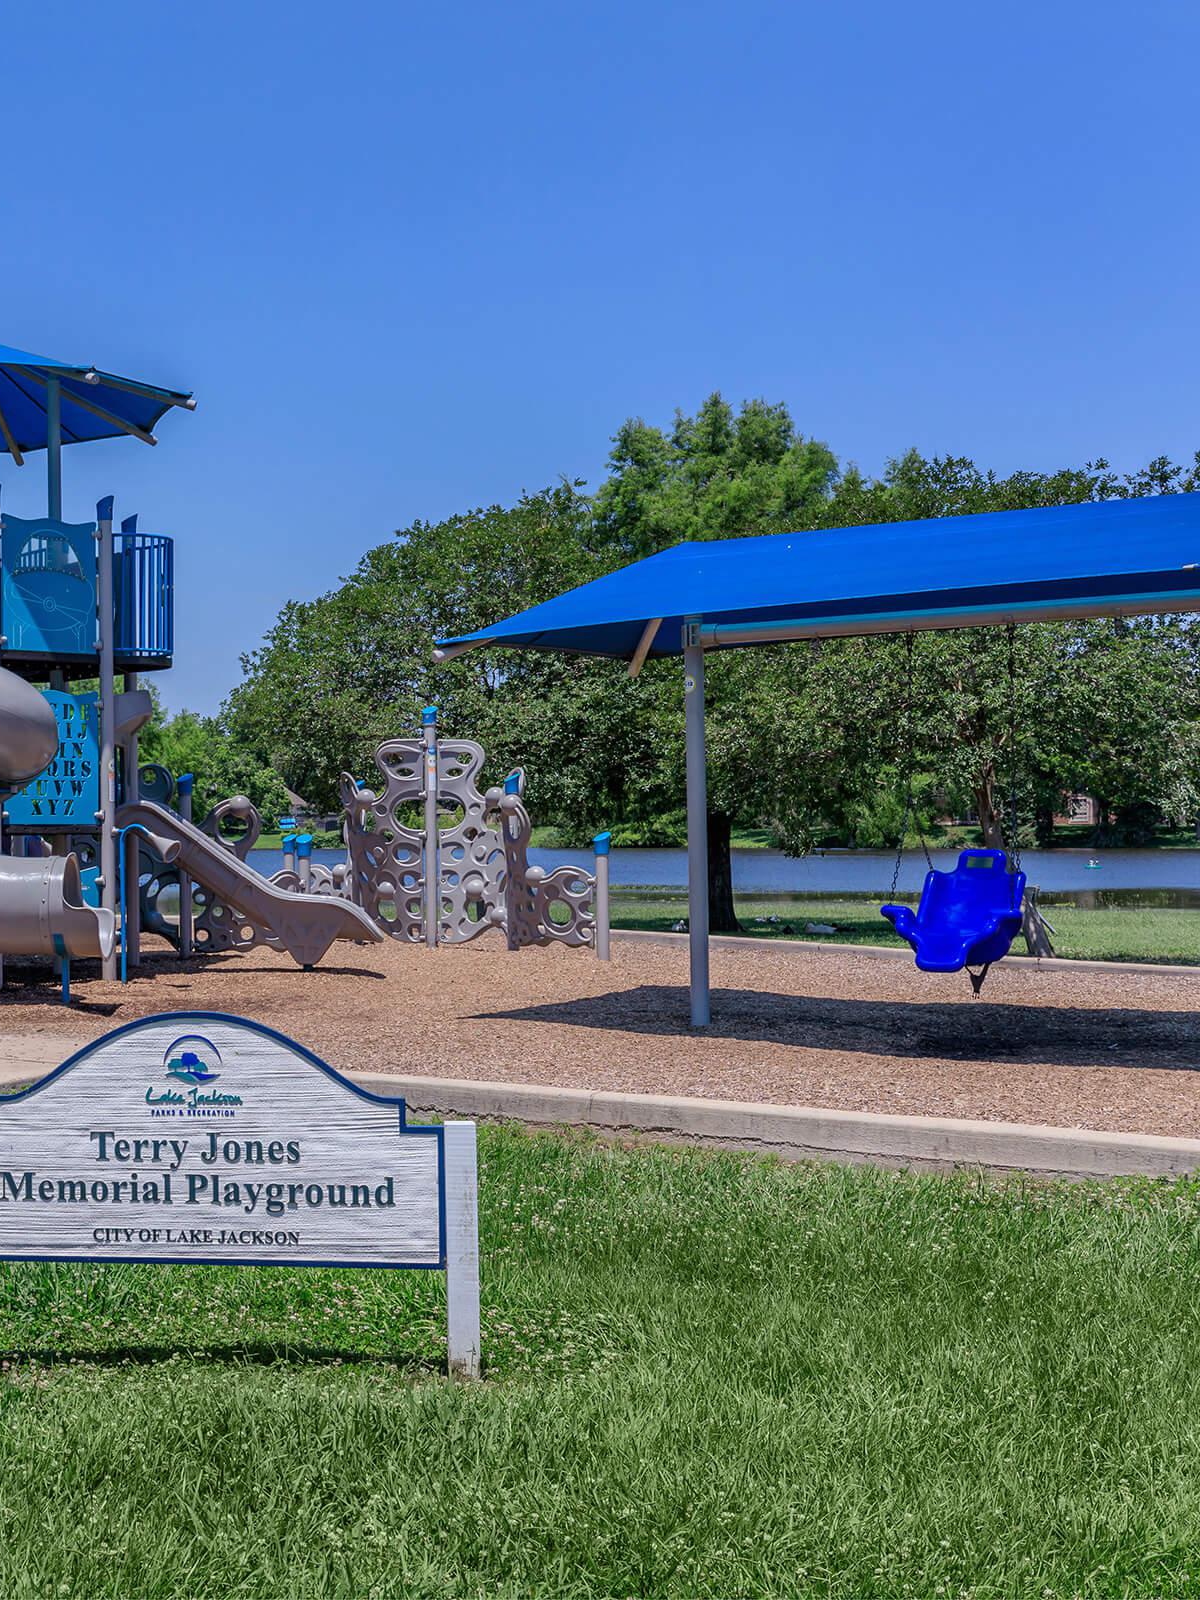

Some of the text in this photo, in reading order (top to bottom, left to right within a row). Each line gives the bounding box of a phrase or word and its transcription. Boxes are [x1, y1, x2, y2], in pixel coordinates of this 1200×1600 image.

[145, 1086, 243, 1108] Lake Jackson
[151, 1109, 235, 1117] PARKS & RECREATION
[90, 1131, 300, 1169] Terry Jones
[0, 1172, 396, 1216] Memorial Playground
[92, 1227, 300, 1246] CITY OF LAKE JACKSON
